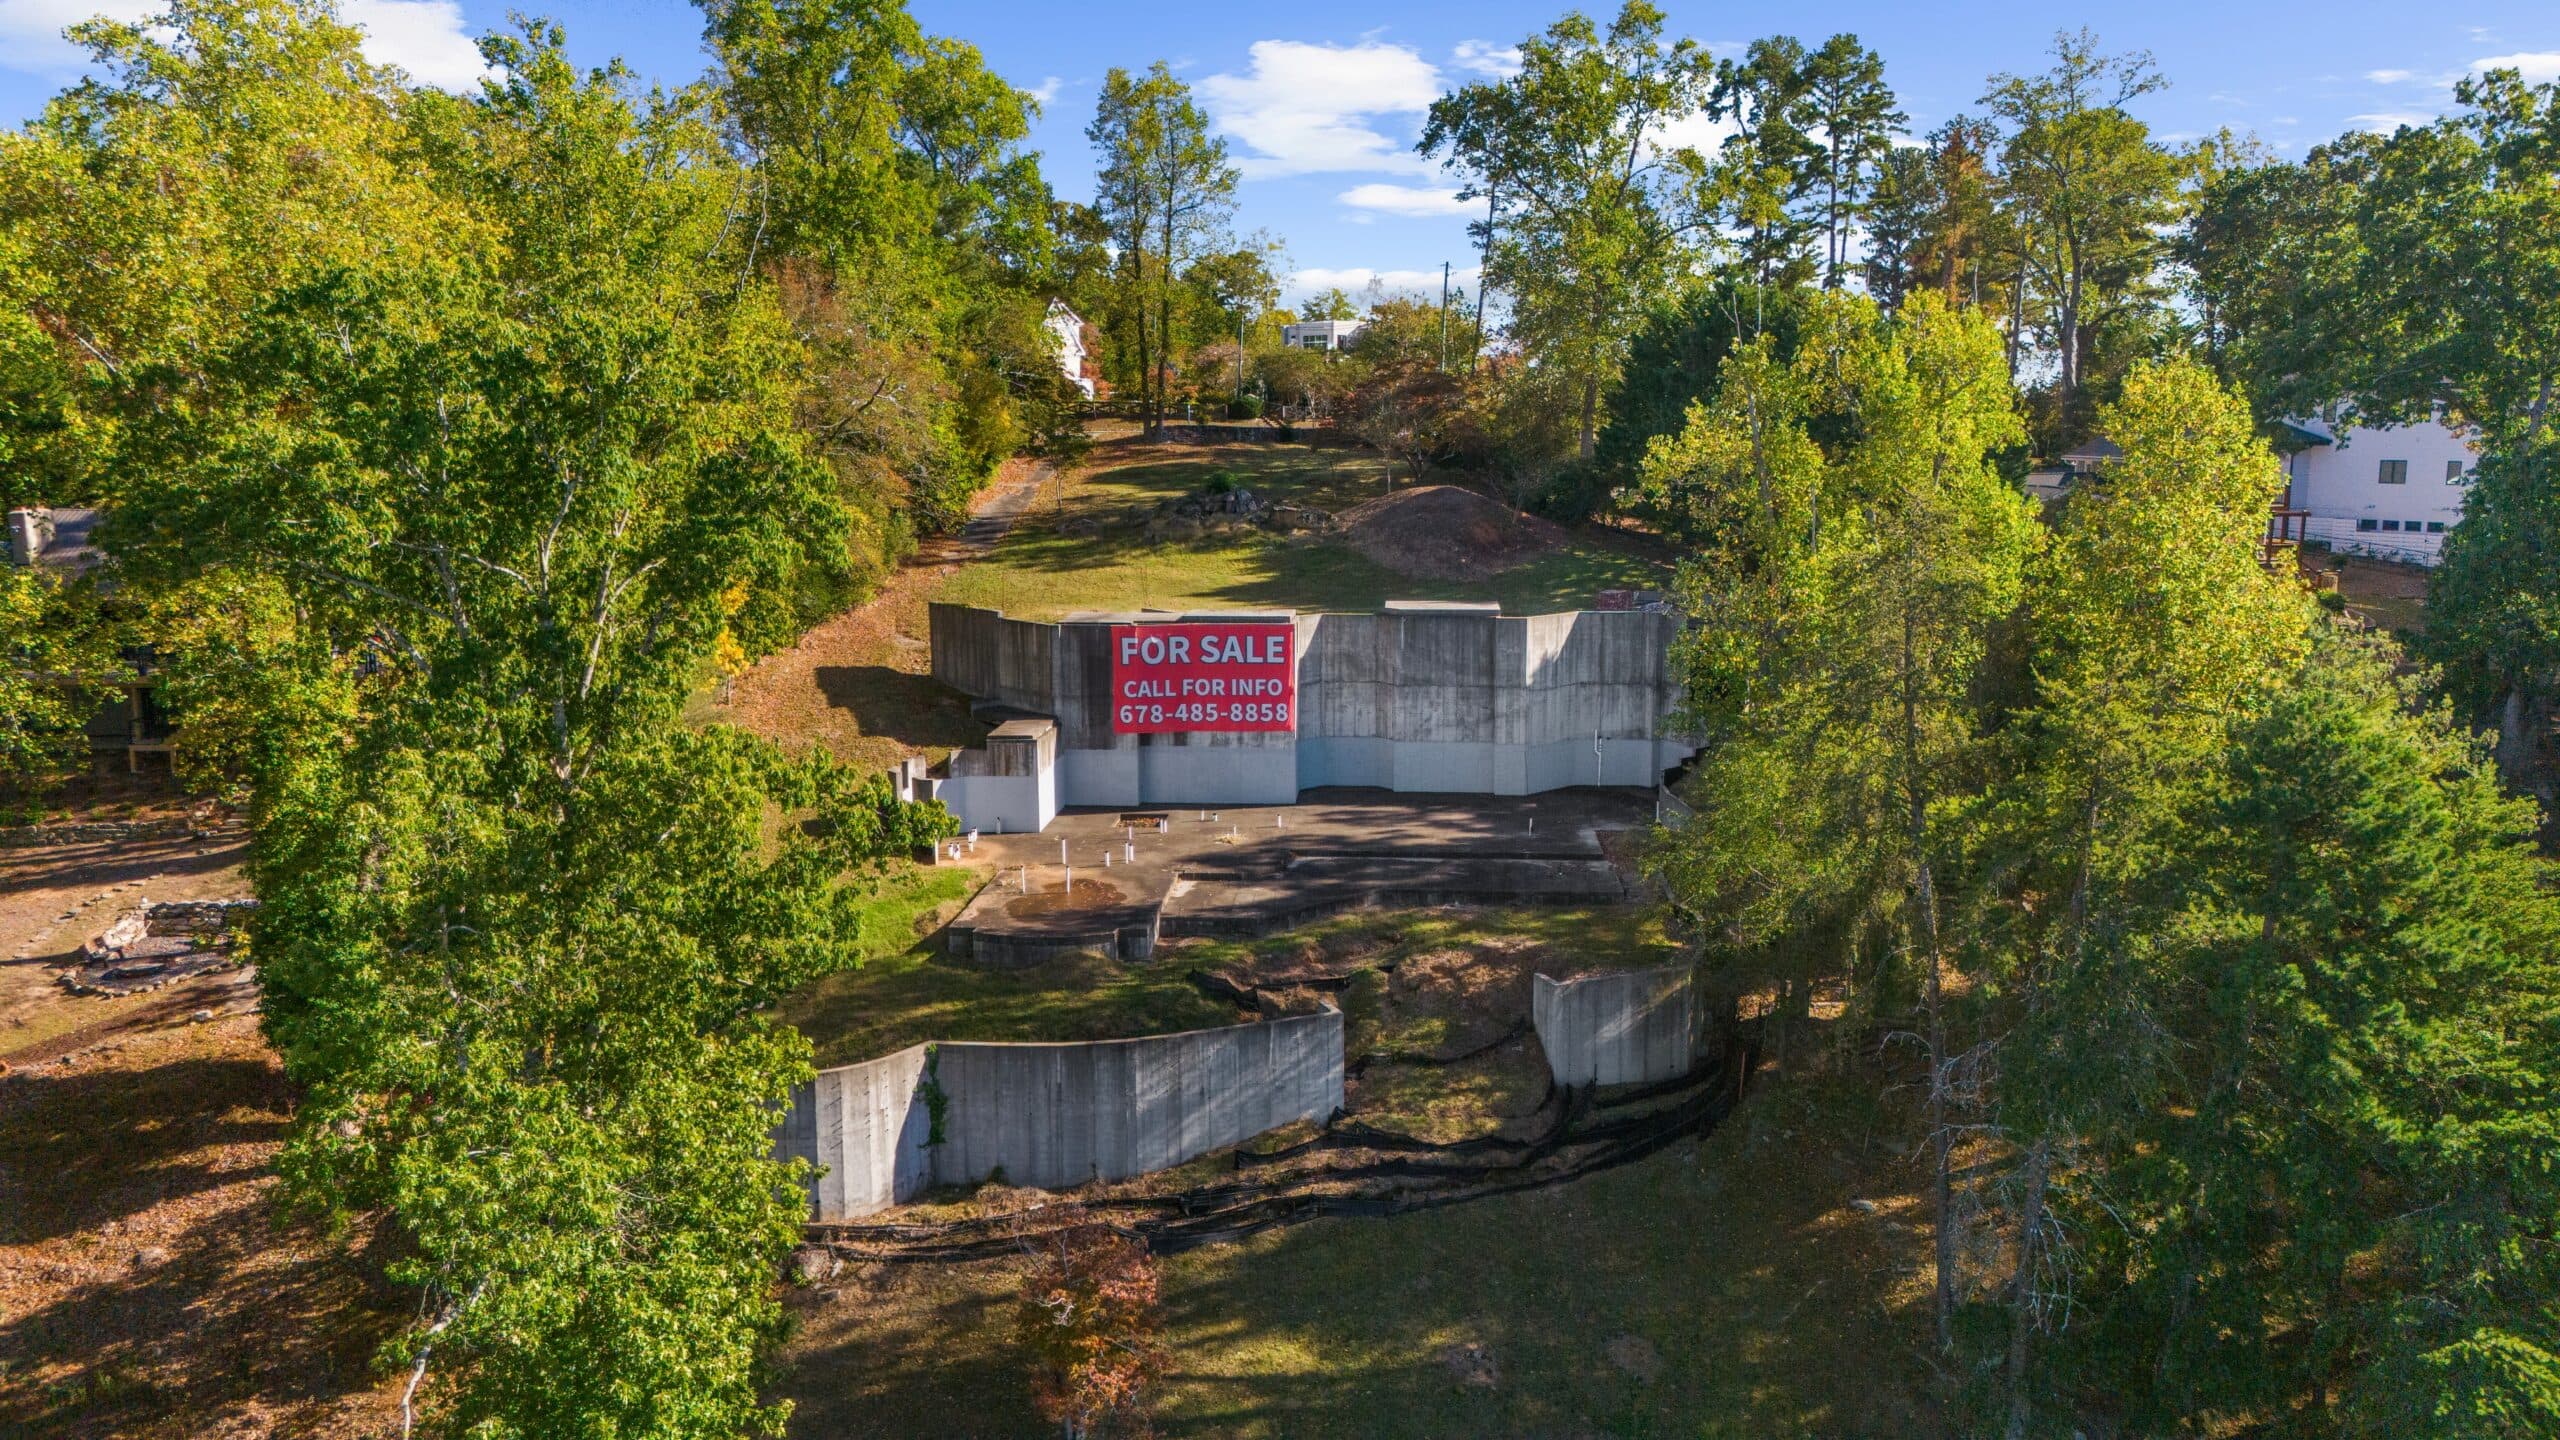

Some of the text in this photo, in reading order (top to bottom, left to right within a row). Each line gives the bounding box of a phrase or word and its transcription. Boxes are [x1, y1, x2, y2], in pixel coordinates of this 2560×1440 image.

[1121, 635, 1285, 665] FOR SALE
[1123, 678, 1283, 698] CALL FOR INFO
[1120, 703, 1288, 724] 678-485-8858
